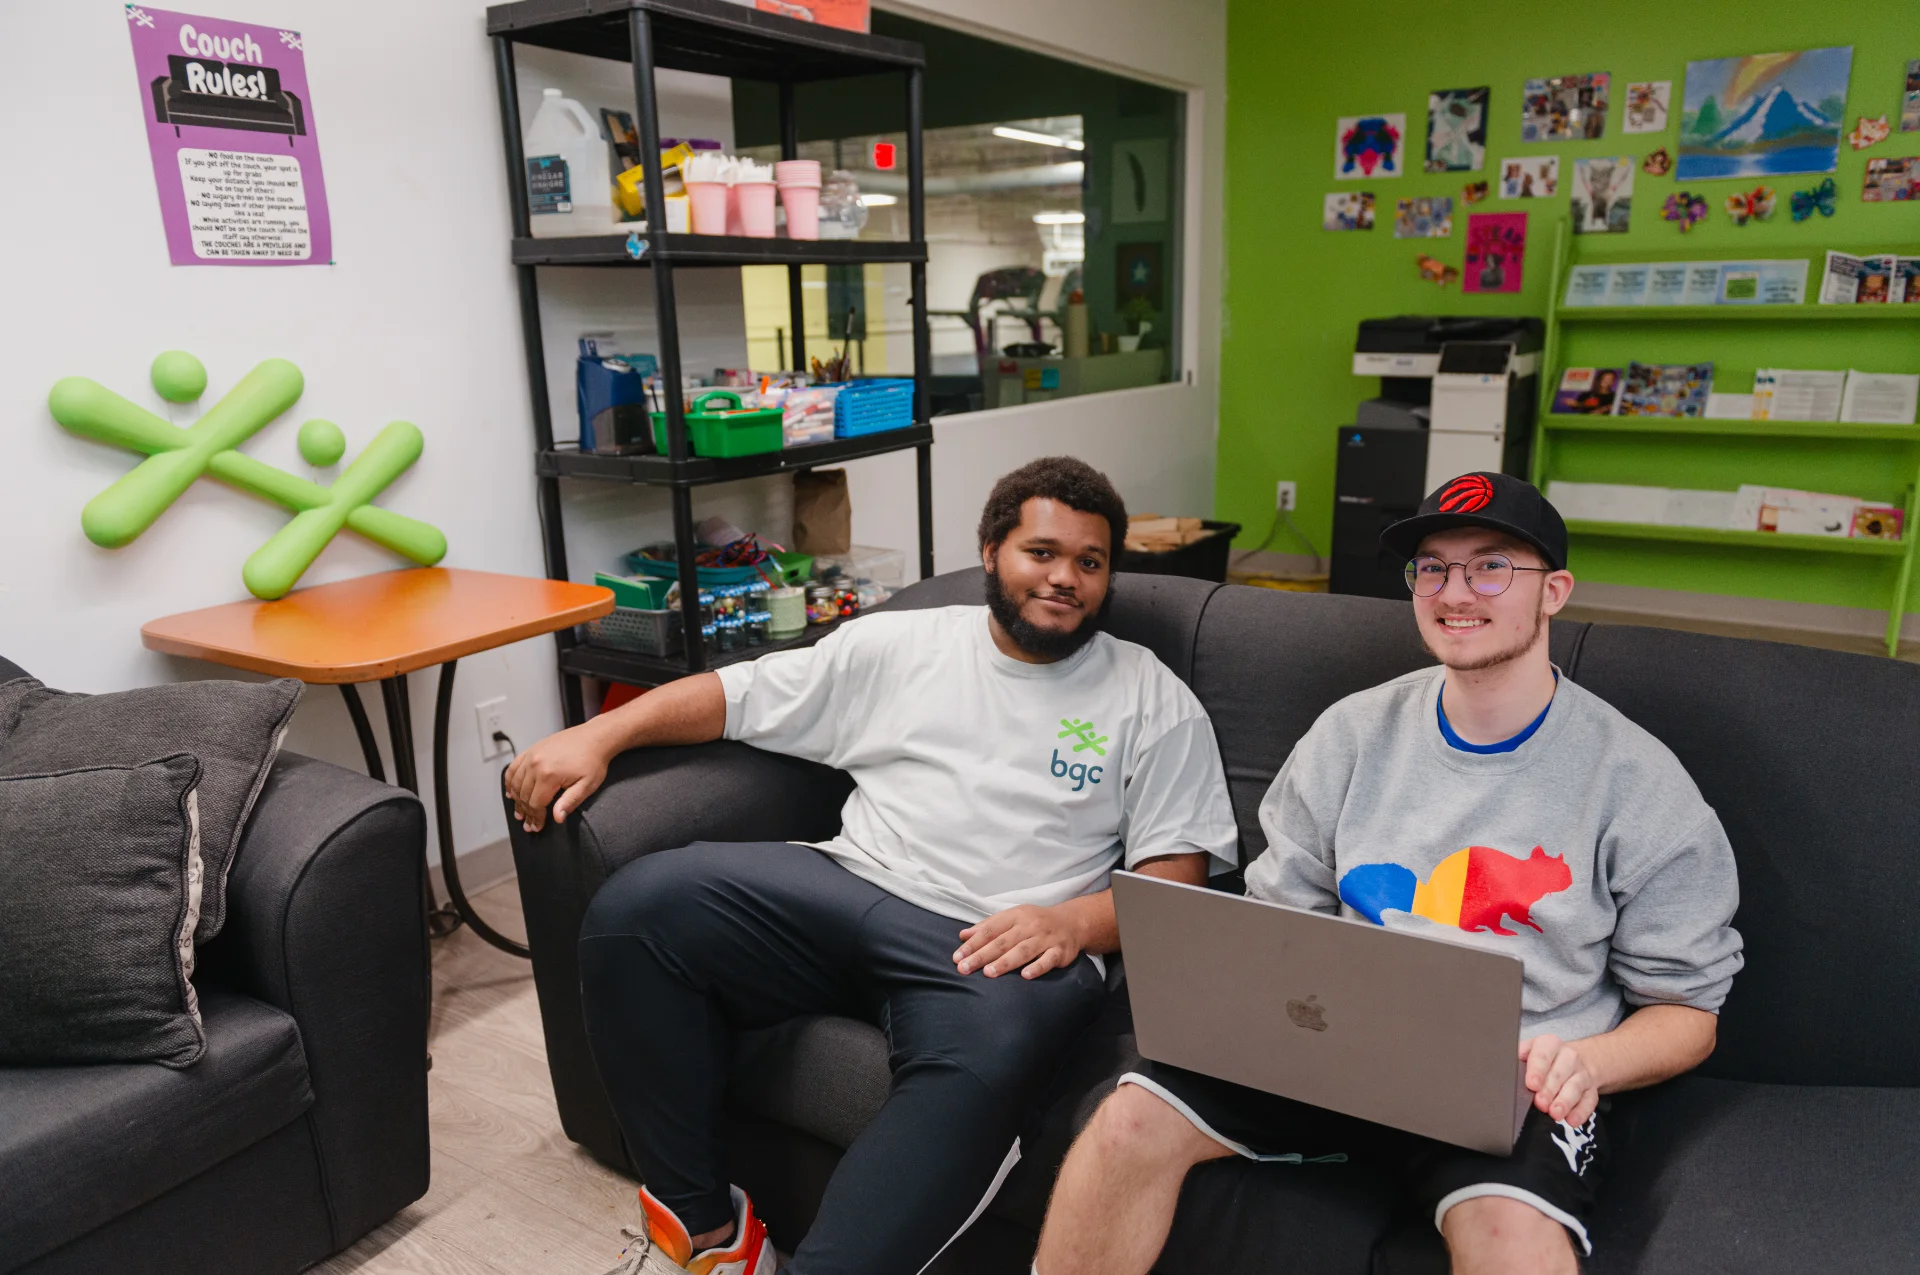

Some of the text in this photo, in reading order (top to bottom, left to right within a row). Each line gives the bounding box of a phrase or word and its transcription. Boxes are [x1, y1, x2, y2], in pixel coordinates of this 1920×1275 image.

[179, 24, 263, 64] Couch
[186, 62, 268, 100] Rules!
[190, 175, 206, 184] Keep
[1050, 748, 1104, 792] bgc
